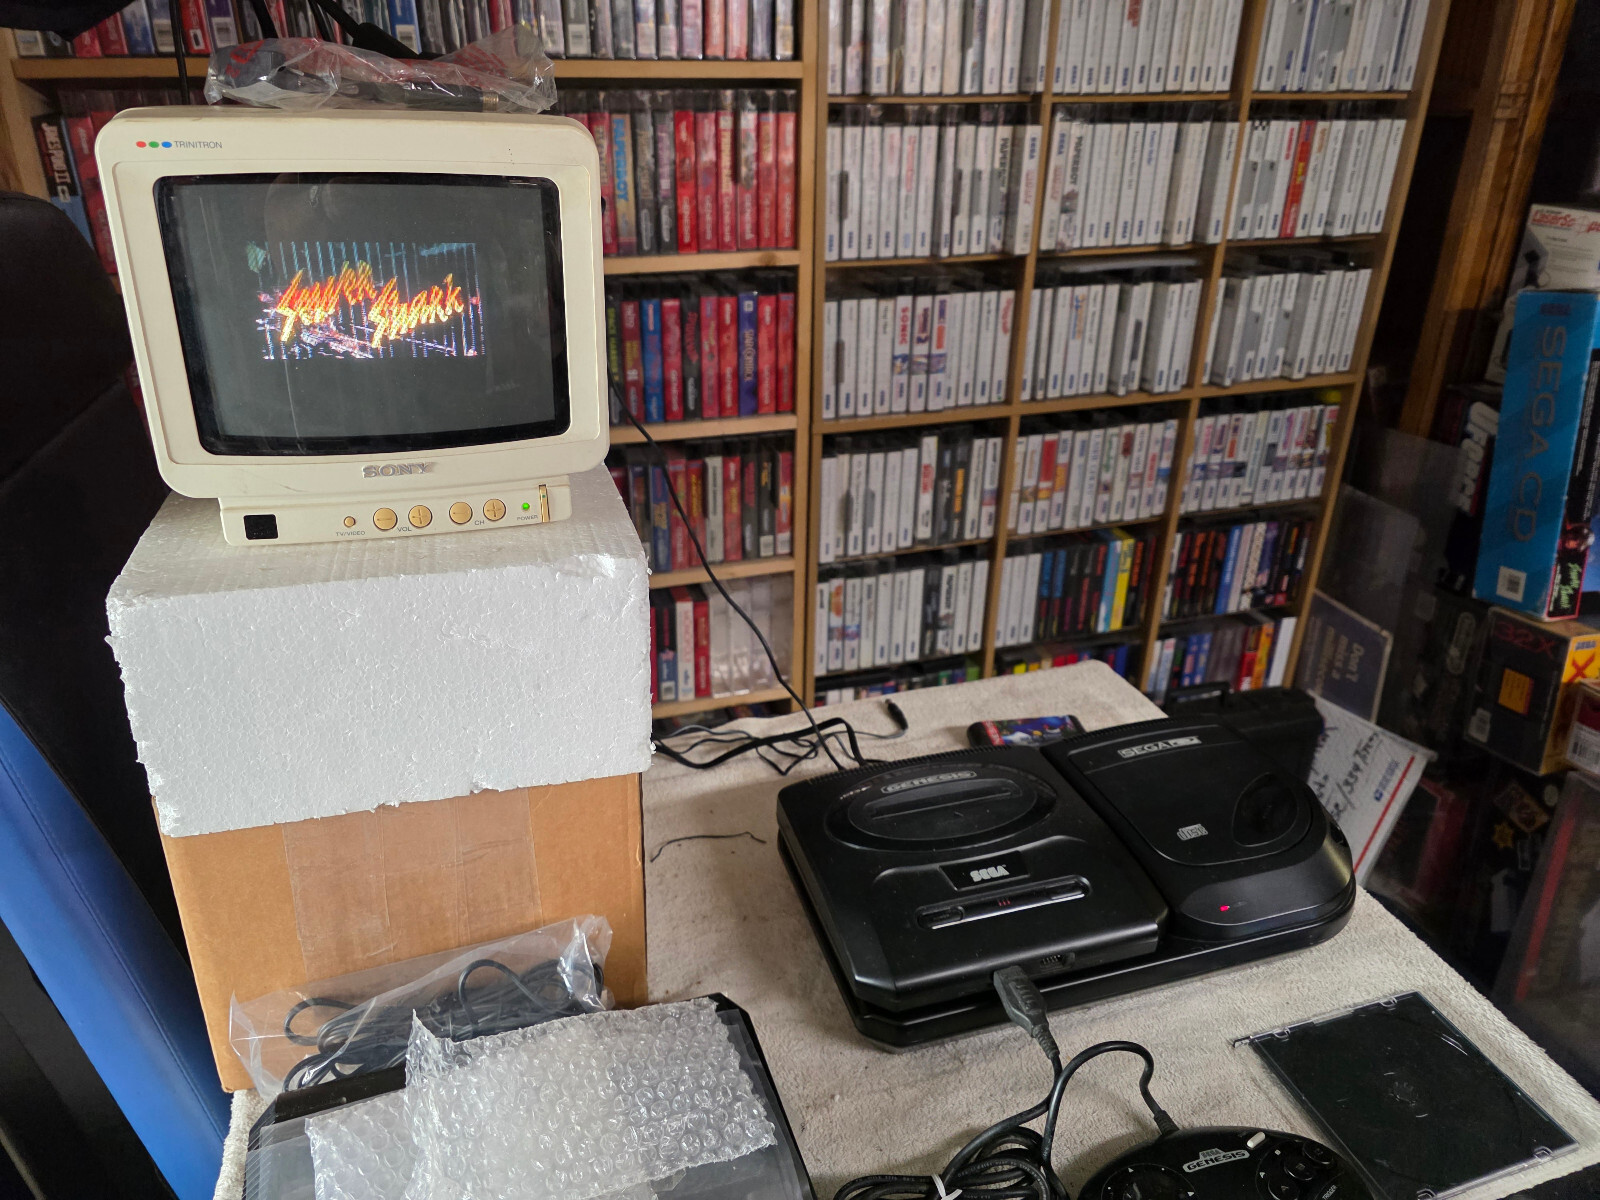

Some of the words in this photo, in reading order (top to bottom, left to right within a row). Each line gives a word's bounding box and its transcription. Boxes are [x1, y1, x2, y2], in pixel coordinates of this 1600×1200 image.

[174, 140, 223, 149] TRINITRON
[613, 118, 629, 203] PAPERBOY
[1069, 136, 1083, 186] PAPERBOY
[898, 306, 909, 345] SONIC
[1524, 326, 1567, 459] SEGA
[362, 462, 431, 479] SONY
[1513, 471, 1543, 543] CD
[473, 519, 486, 527] CH
[516, 514, 540, 522] POWER
[335, 530, 366, 538] TV/VIDEO
[396, 525, 413, 533] VOL
[1120, 742, 1172, 758] SEGA
[882, 771, 977, 794] GENESIS
[970, 865, 1010, 883] SEGA
[1186, 1150, 1248, 1171] GENESIS
